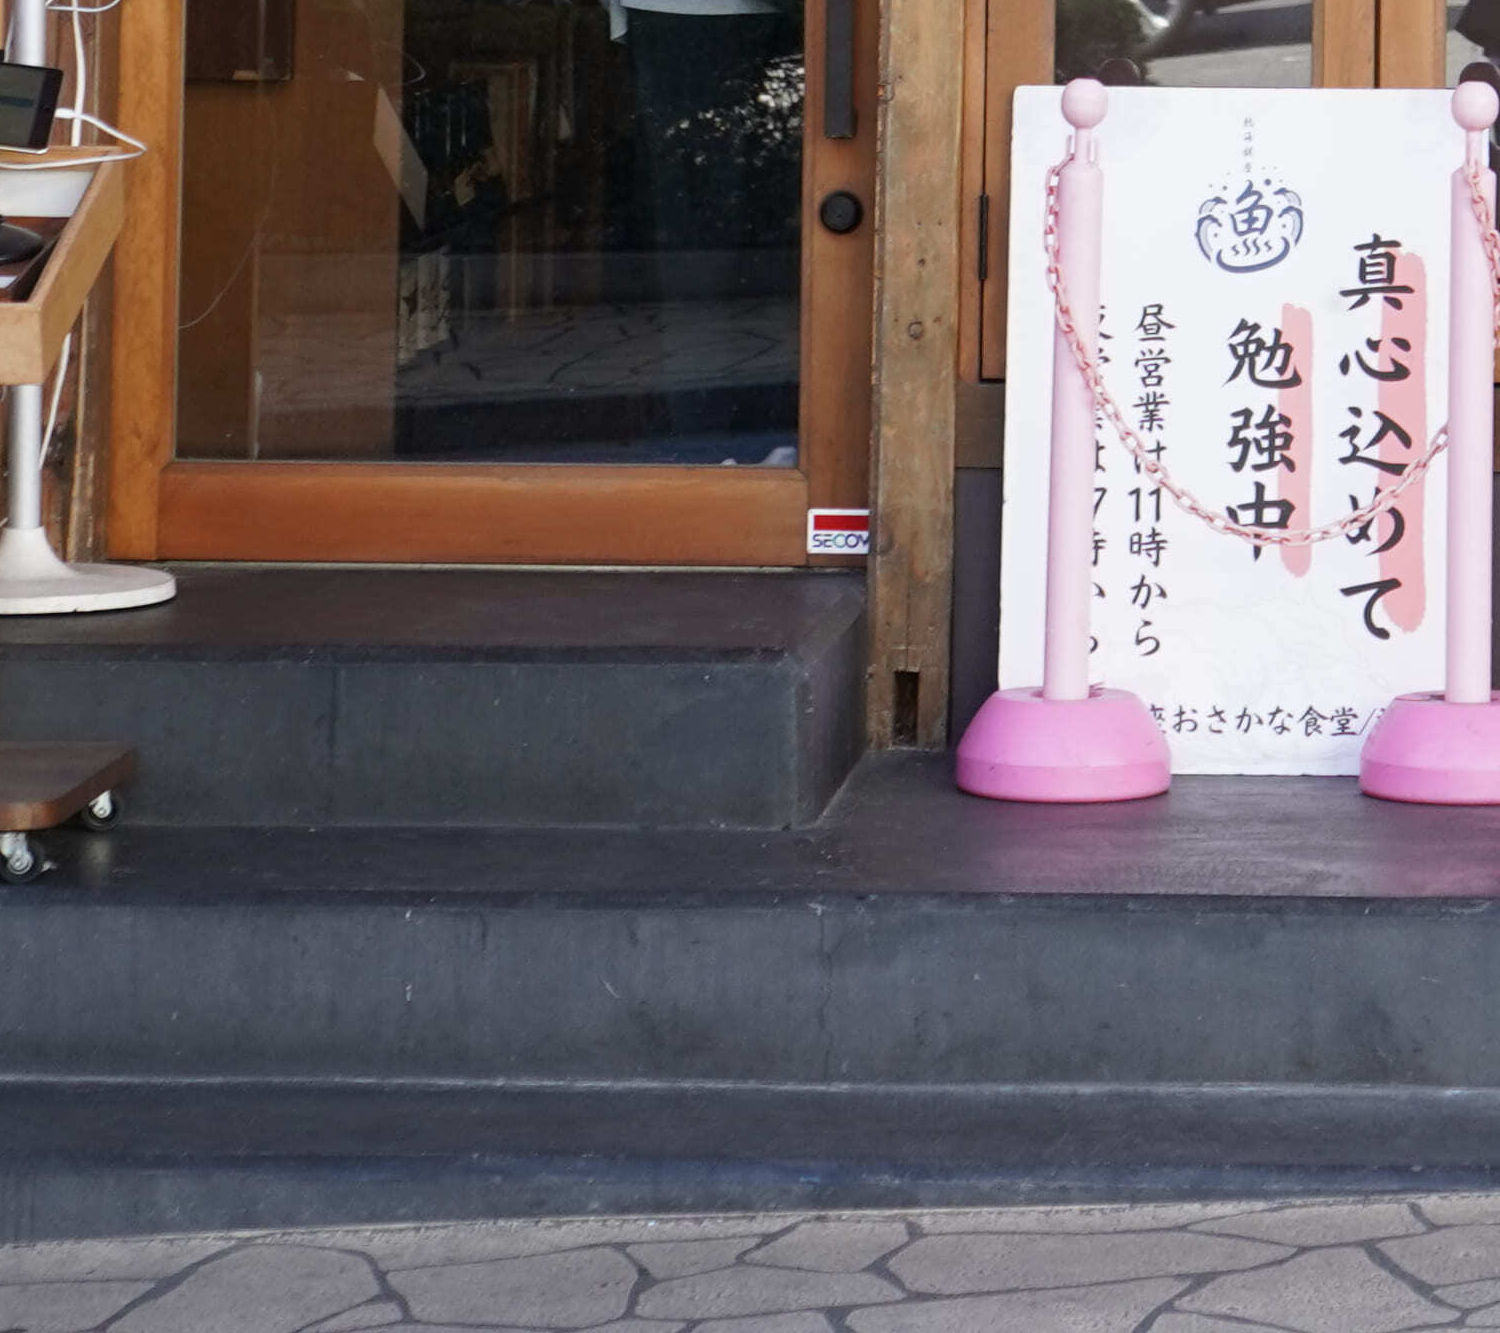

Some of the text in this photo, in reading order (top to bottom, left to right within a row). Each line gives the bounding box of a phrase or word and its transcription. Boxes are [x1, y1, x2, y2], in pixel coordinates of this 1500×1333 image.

[1224, 318, 1304, 564] 勉強中
[1338, 233, 1417, 641] 真心込めて
